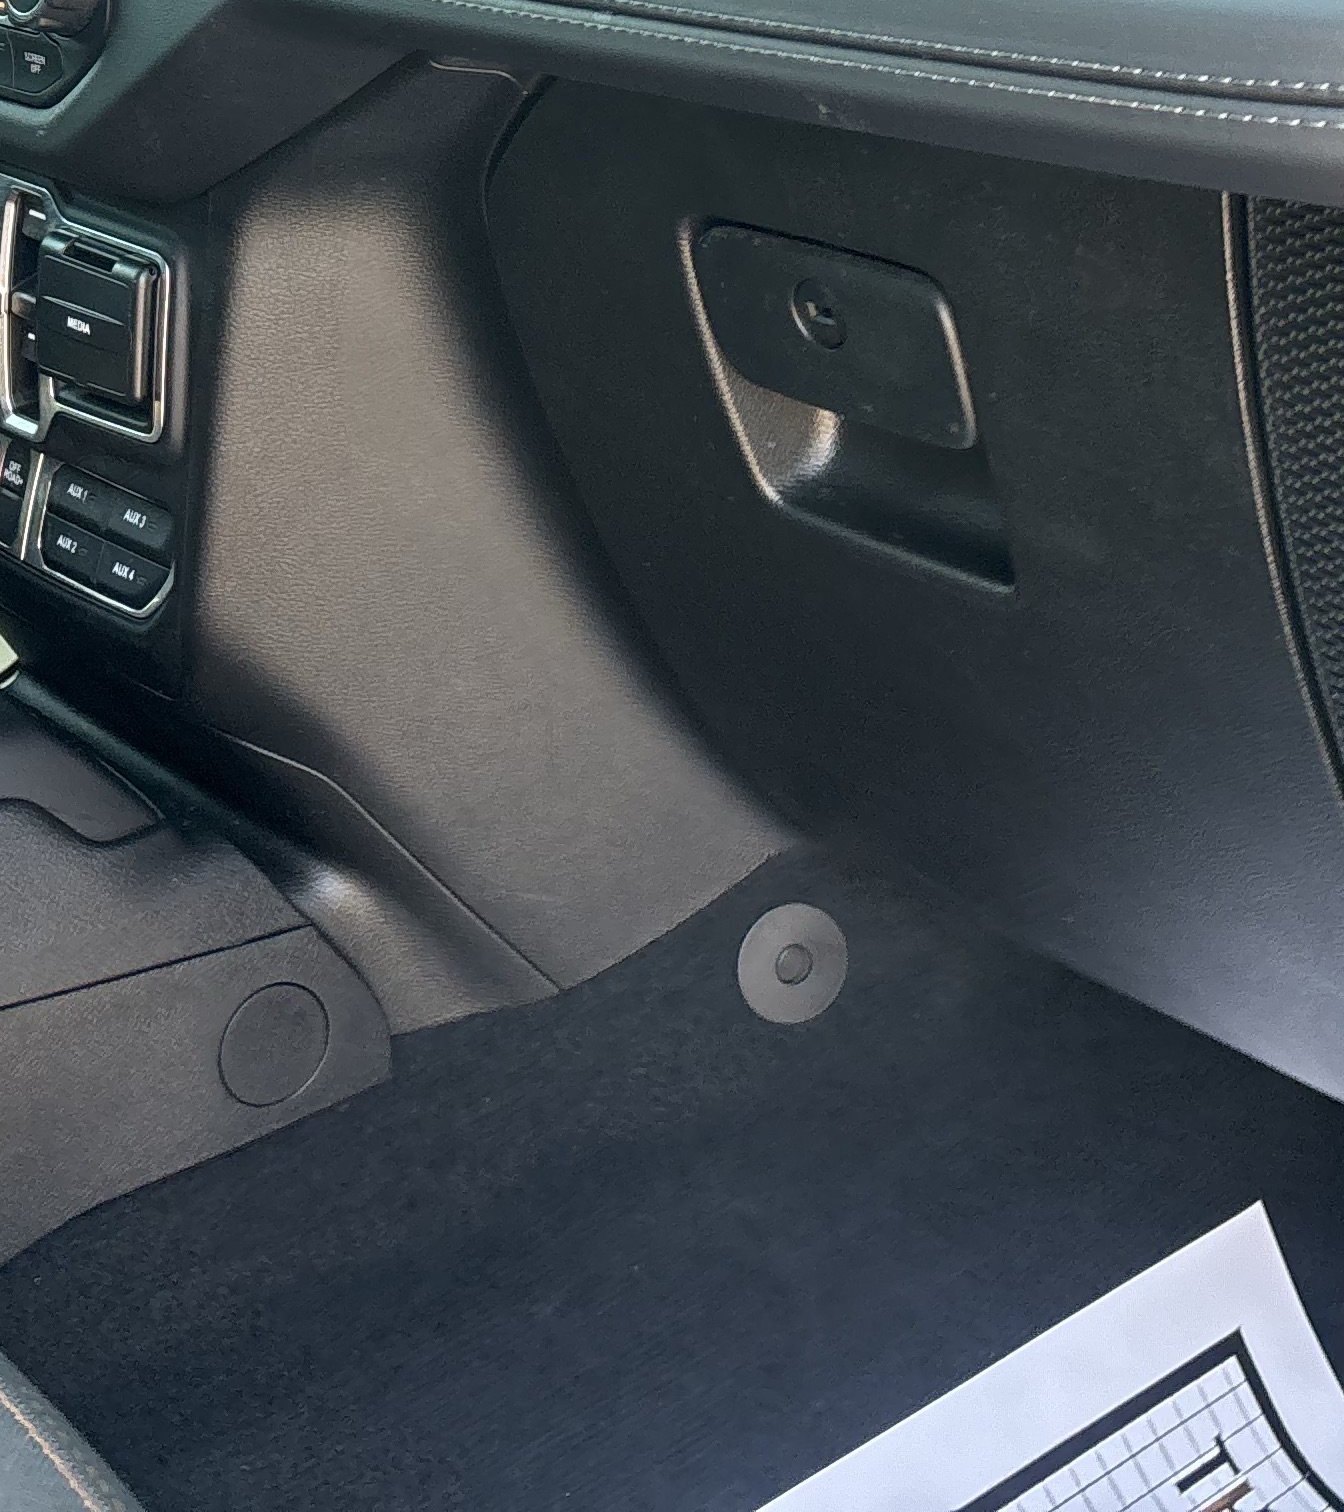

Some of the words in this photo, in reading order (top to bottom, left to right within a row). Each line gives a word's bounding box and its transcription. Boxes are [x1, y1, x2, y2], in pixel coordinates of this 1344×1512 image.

[67, 315, 91, 336] MEDIA
[8, 460, 22, 474] OFF
[66, 483, 84, 500] AUX
[122, 508, 141, 526] AUX
[56, 534, 73, 551] AUX
[112, 561, 130, 579] AUX
